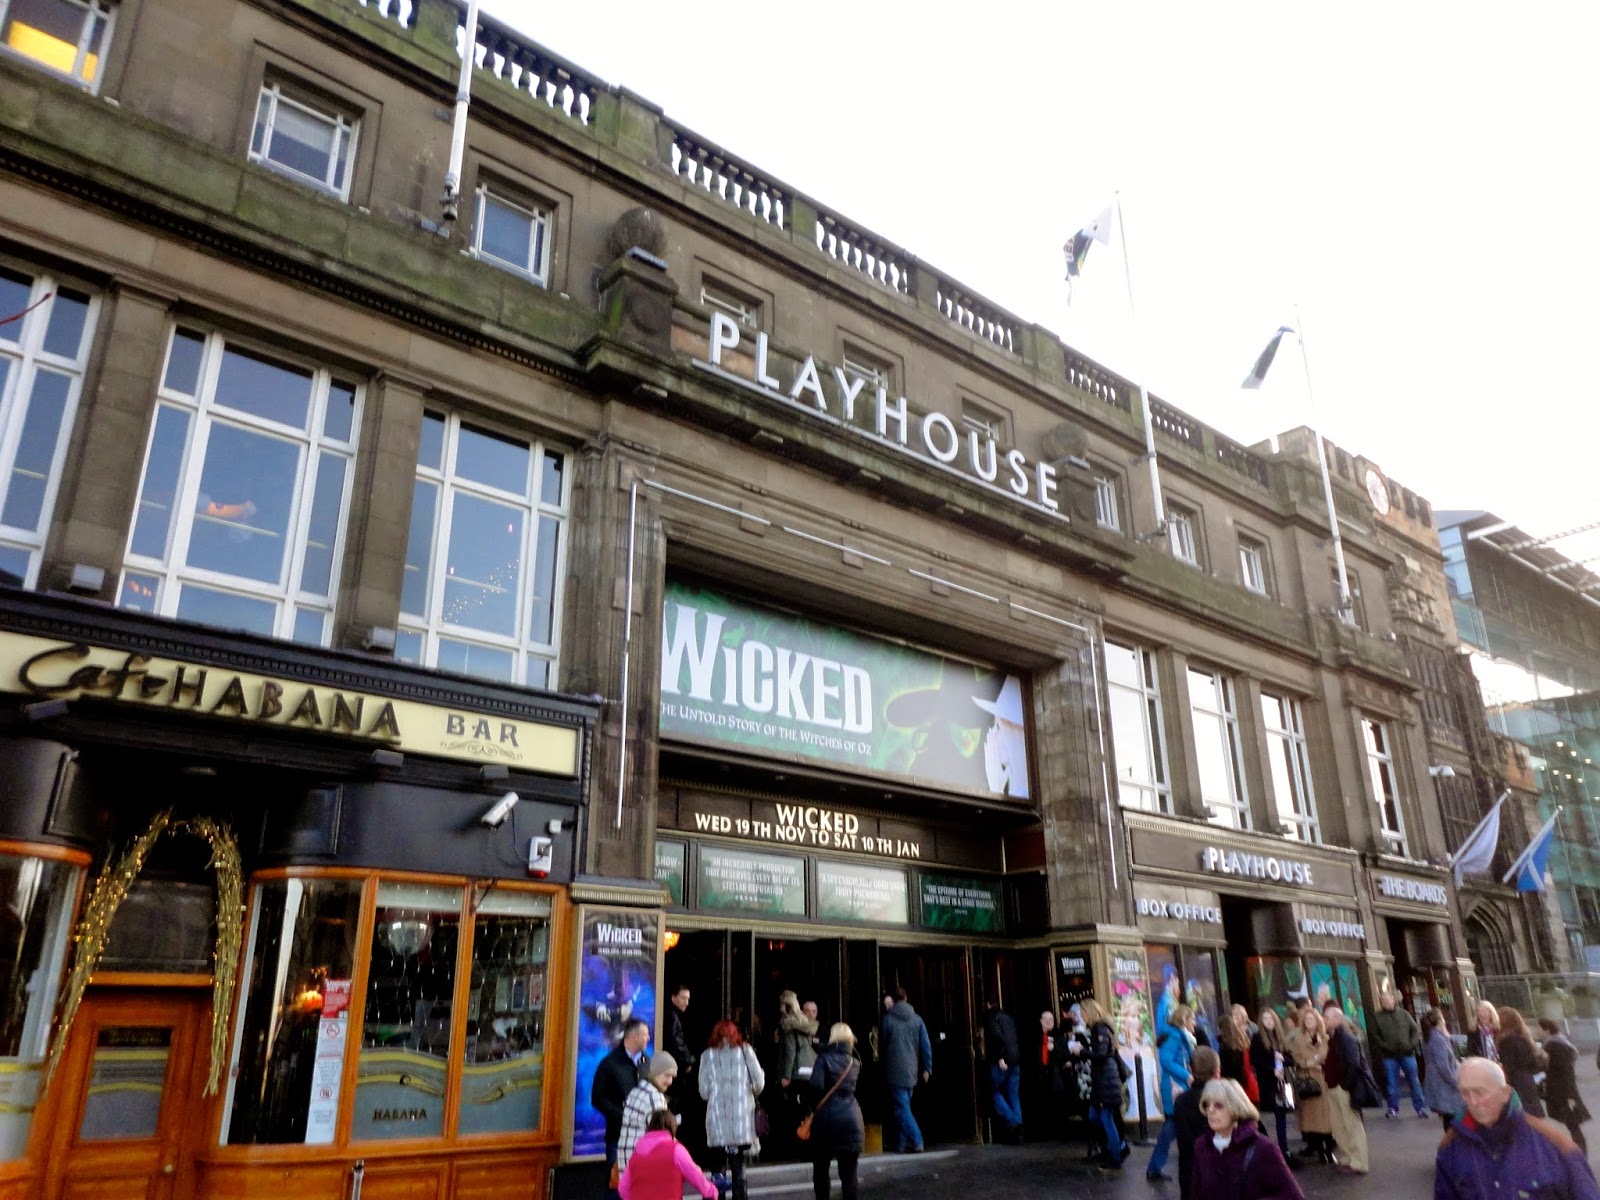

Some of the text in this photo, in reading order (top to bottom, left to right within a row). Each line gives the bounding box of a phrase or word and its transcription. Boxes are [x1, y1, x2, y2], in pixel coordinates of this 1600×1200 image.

[709, 311, 1059, 510] PLAYHOUSE
[172, 664, 403, 738] HABANA
[445, 713, 520, 747] BAR
[680, 705, 726, 727] UNTOLD
[728, 715, 762, 734] STORY
[763, 724, 776, 737] OF
[779, 727, 797, 742] THE
[800, 730, 842, 749] WITCHES
[844, 741, 856, 751] OF
[694, 812, 920, 858] WED 19 TH NOV TO SAT 10 TH JAN
[776, 803, 859, 835] WICKED
[752, 871, 771, 883] EVERY
[1202, 846, 1313, 886] PLAYHOUSE
[1381, 876, 1447, 905] THE BOARDS
[1137, 898, 1222, 925] BOX OFFICE
[597, 922, 642, 943] WICKED
[1301, 917, 1366, 940] BOX OFFICE
